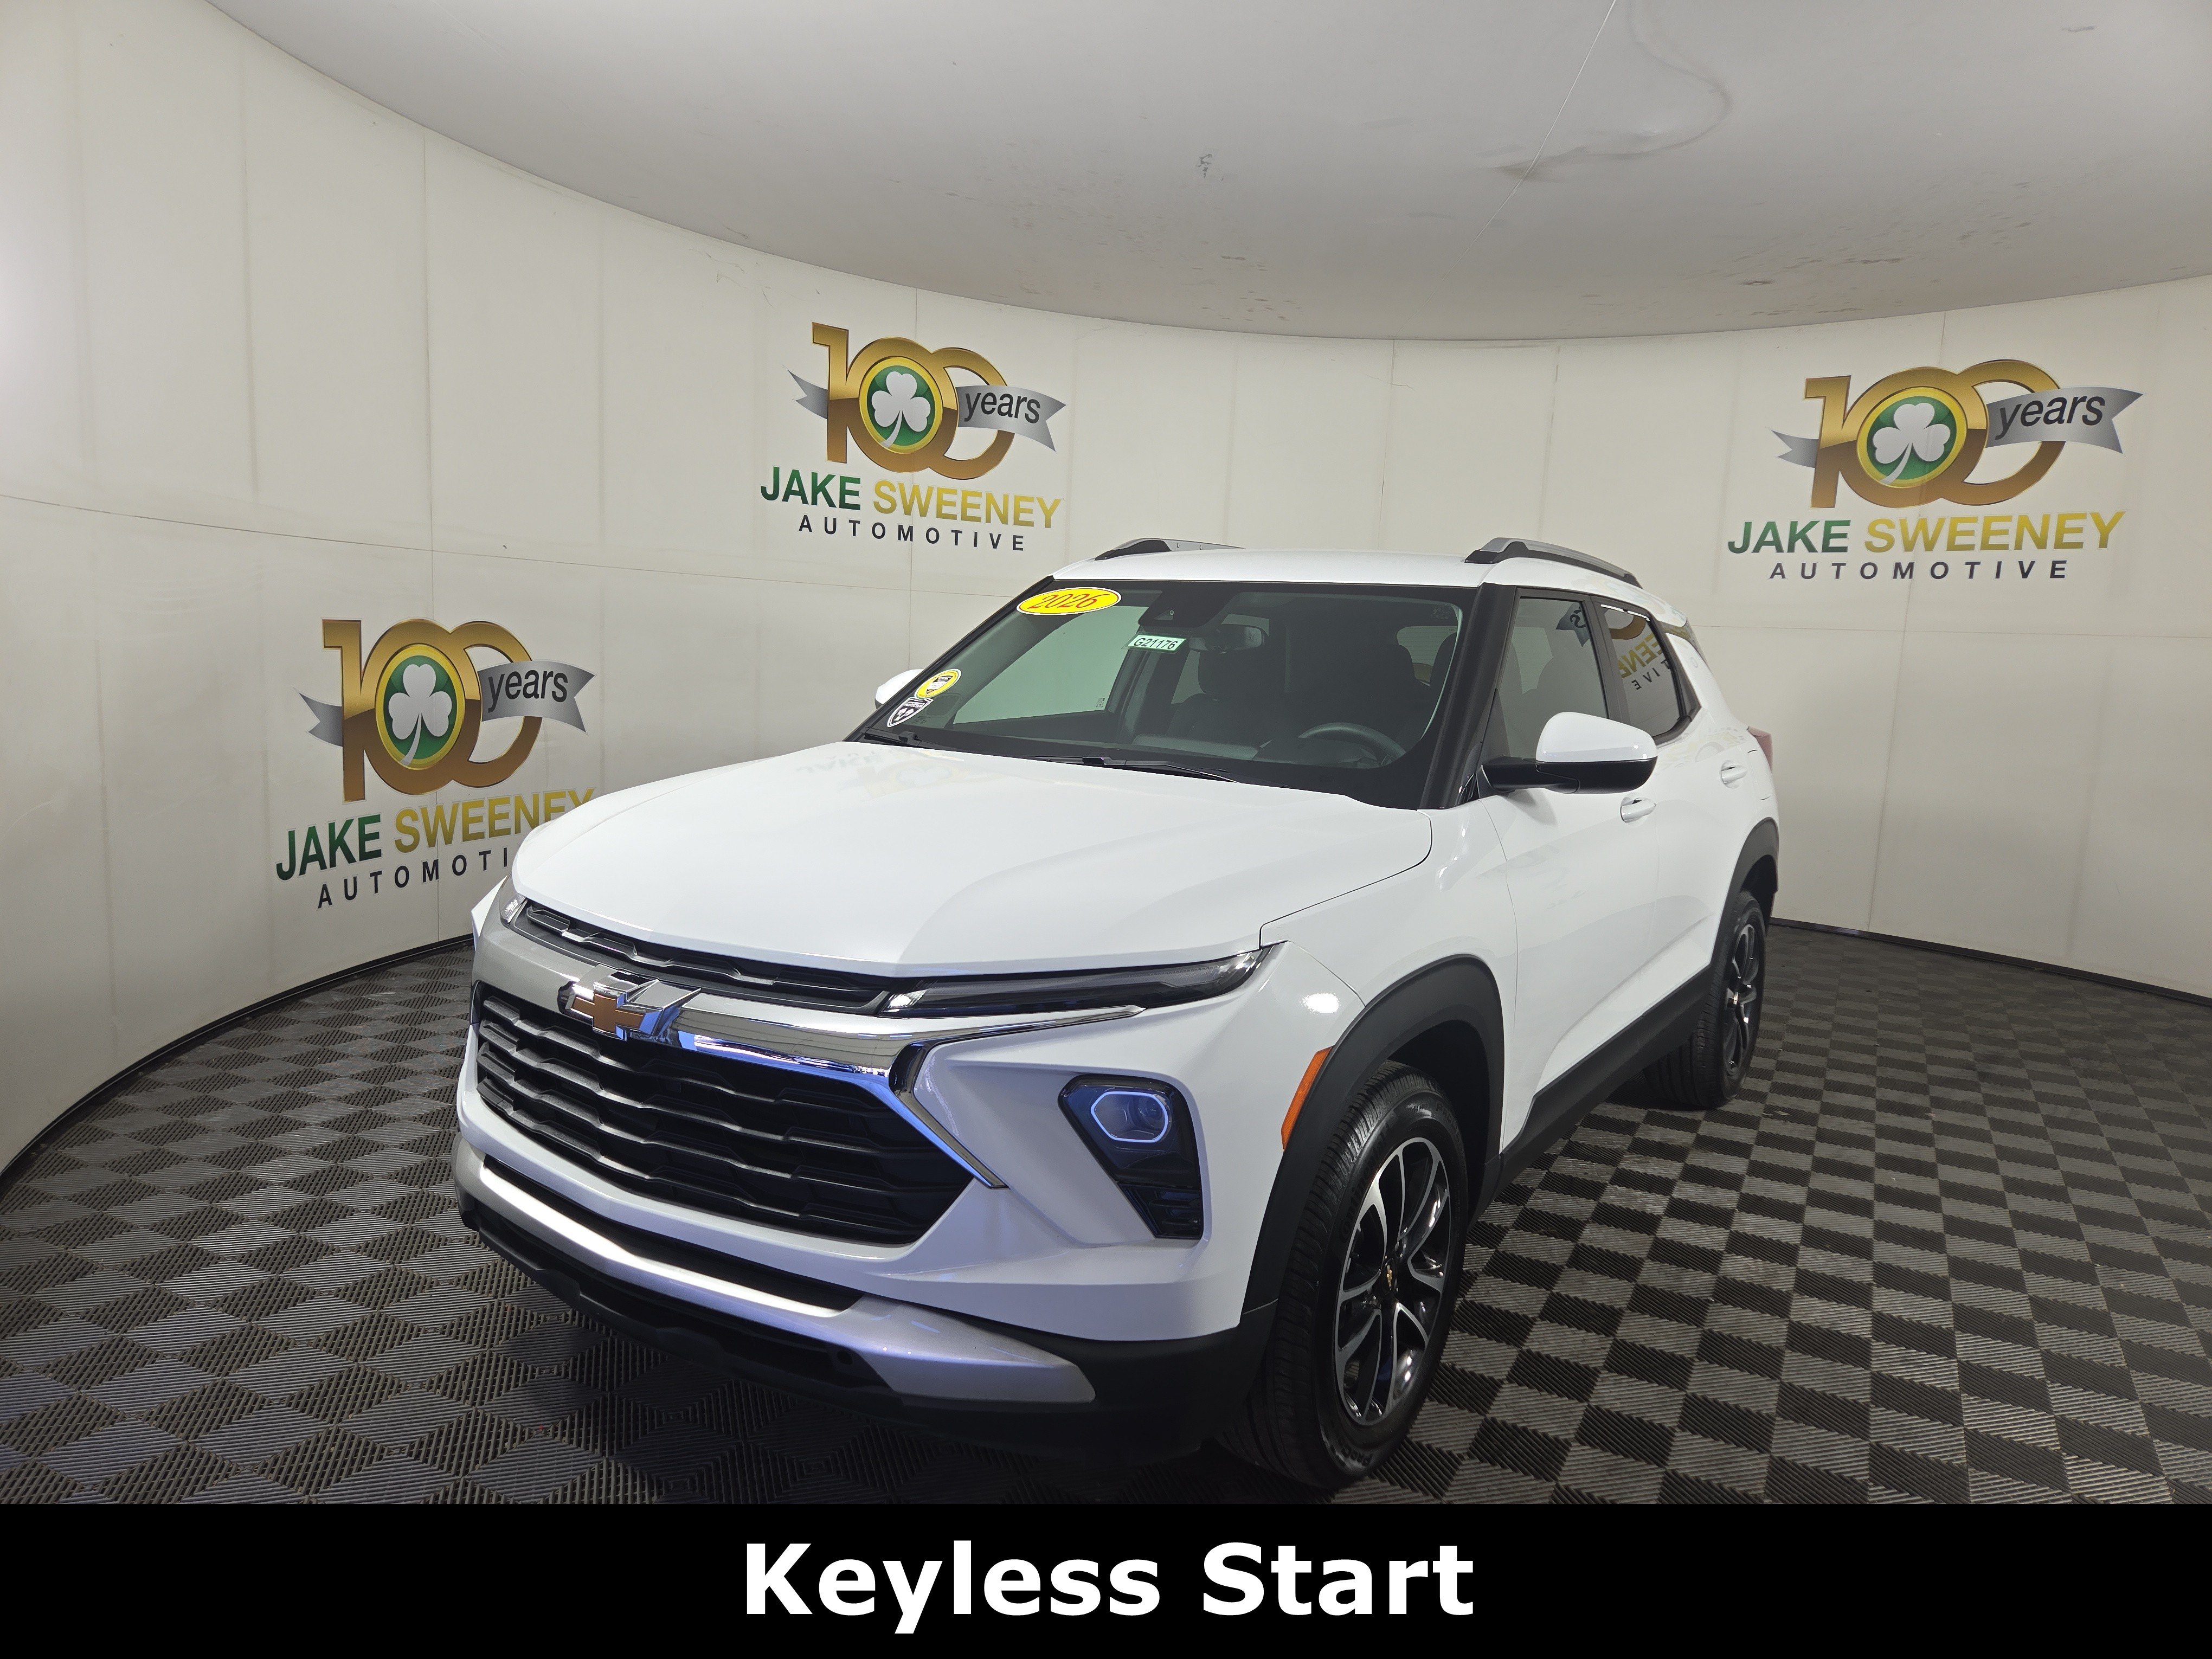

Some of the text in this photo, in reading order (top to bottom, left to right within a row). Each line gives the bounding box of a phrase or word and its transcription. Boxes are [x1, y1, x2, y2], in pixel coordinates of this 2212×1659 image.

[963, 392, 1041, 425] years
[1994, 394, 2106, 440] years
[760, 466, 1062, 529] JAKE SWEENEY
[799, 515, 1025, 551] AUTOMOTIVE
[1727, 511, 2127, 554] JAKE SWEENEY
[1769, 560, 2067, 580] AUTOMOTIVE
[1028, 593, 1110, 609] 2026
[1134, 638, 1179, 650] G21176
[488, 669, 568, 713] years
[275, 814, 382, 881] JAKE
[317, 847, 507, 909] AUTOMOTI
